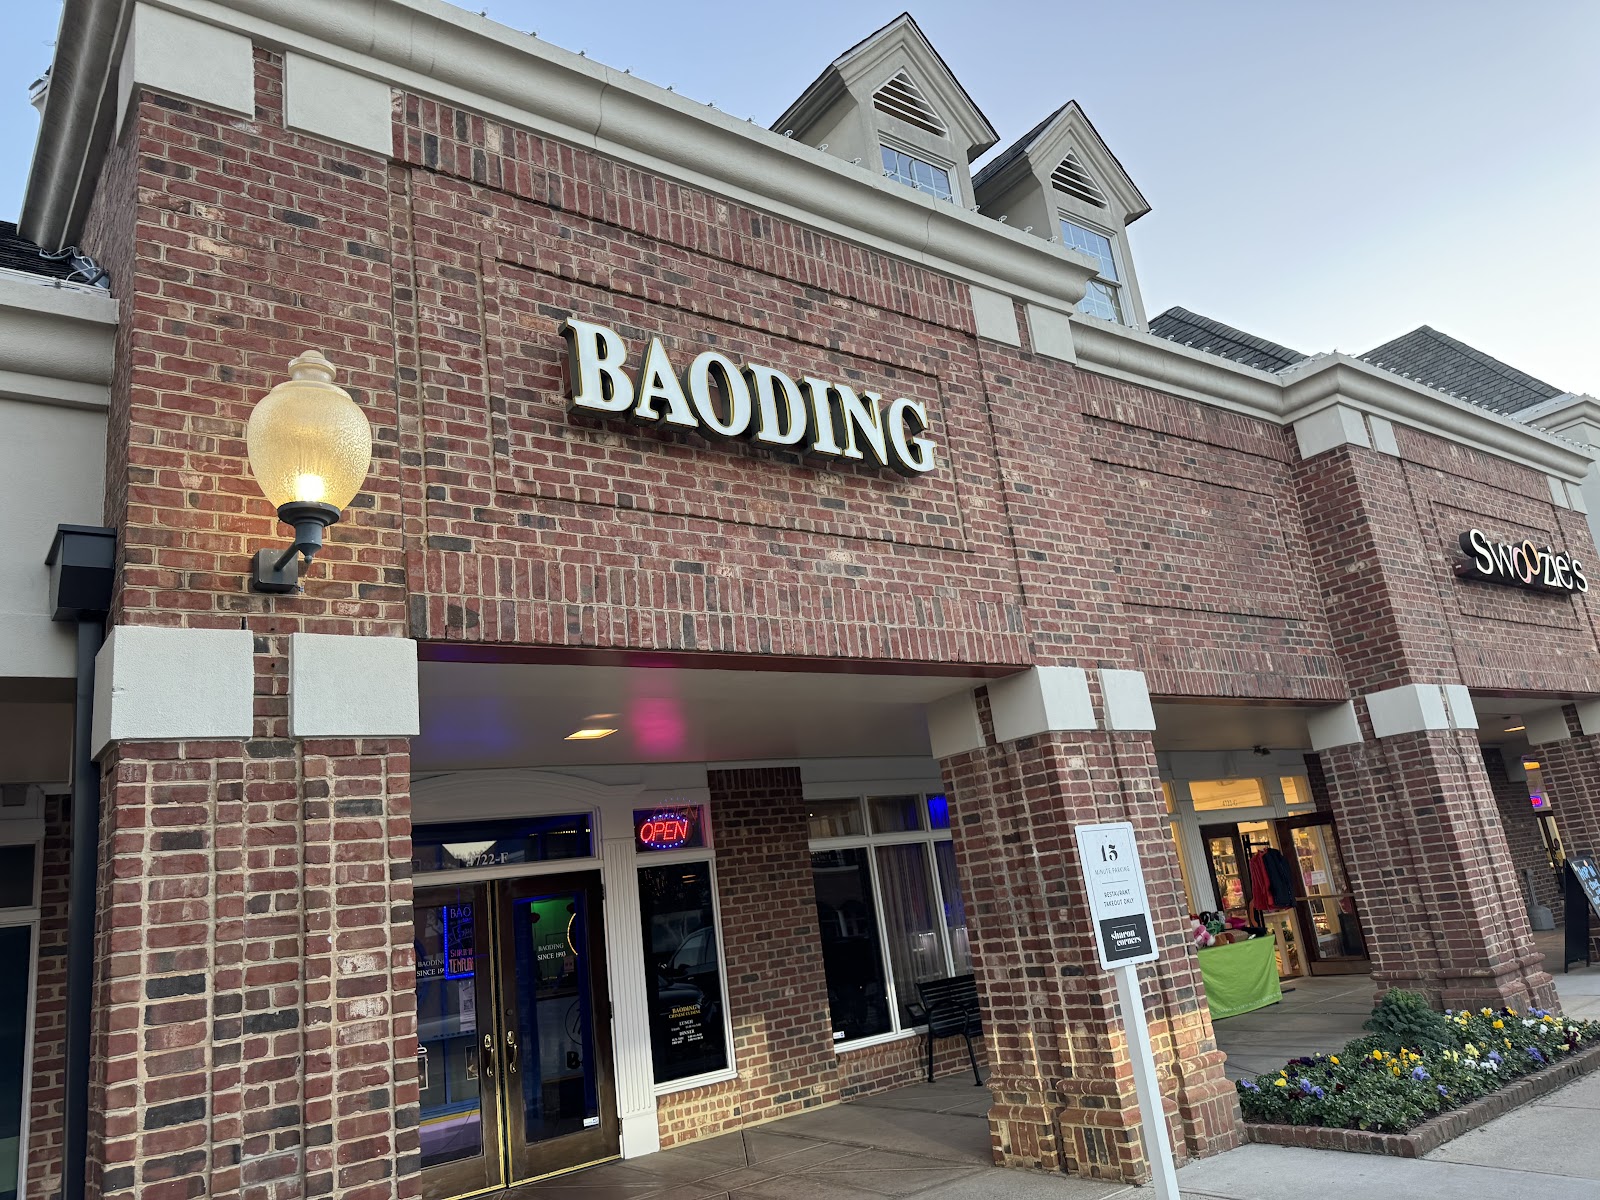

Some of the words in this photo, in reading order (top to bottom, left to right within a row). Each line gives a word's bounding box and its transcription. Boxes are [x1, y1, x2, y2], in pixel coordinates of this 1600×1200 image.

[559, 317, 937, 475] BAODING
[640, 820, 688, 842] OPEN
[1101, 844, 1118, 862] 15
[1103, 889, 1131, 898] RESTAURANT
[1103, 899, 1123, 907] TAKEOUT
[1110, 929, 1136, 941] sharon
[1116, 935, 1142, 947] corners
[538, 942, 564, 952] BAODING
[537, 952, 555, 961] SINCE
[416, 968, 436, 978] SINCE
